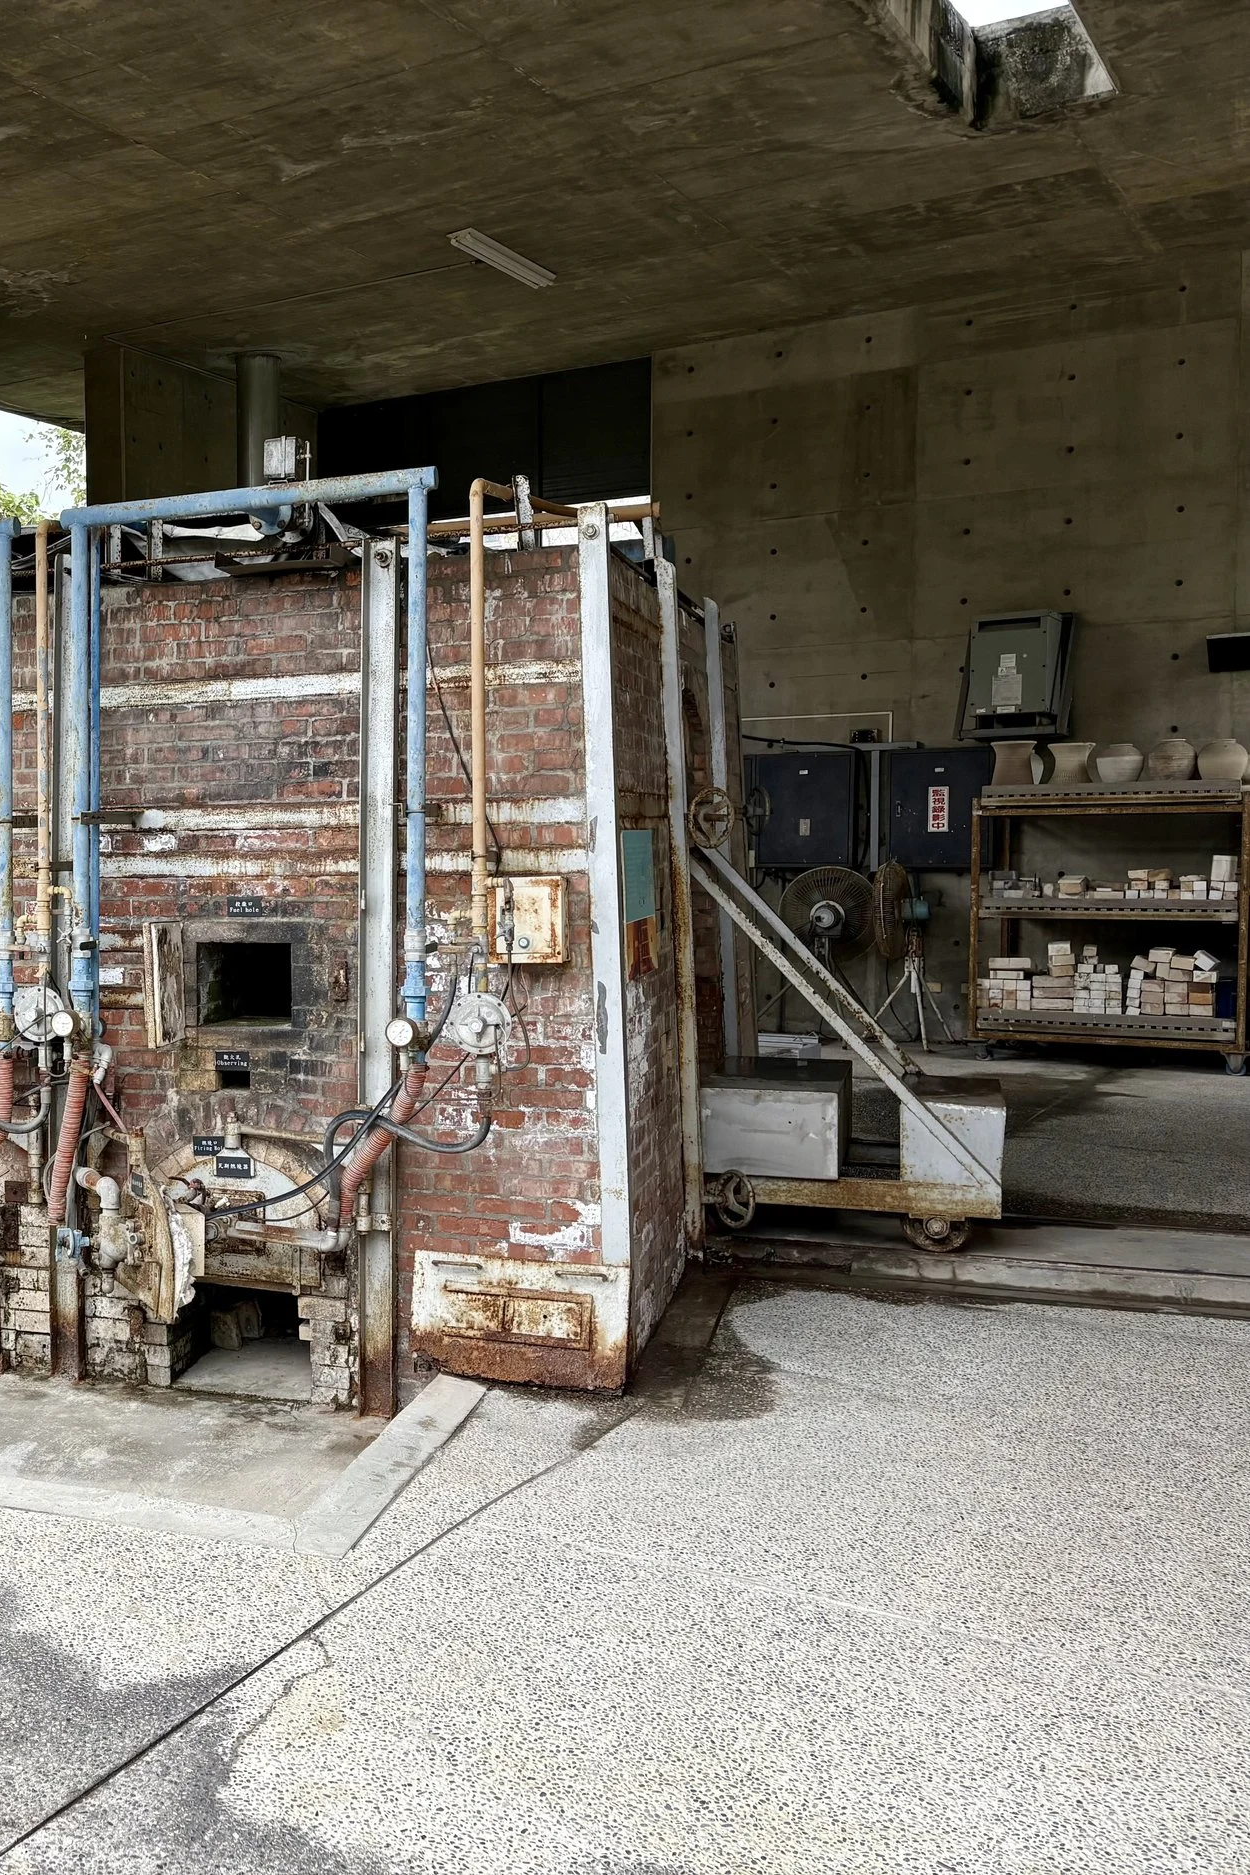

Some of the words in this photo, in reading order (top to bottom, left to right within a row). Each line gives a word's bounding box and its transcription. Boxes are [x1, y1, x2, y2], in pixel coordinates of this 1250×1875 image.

[931, 789, 946, 830] 監視錄影中
